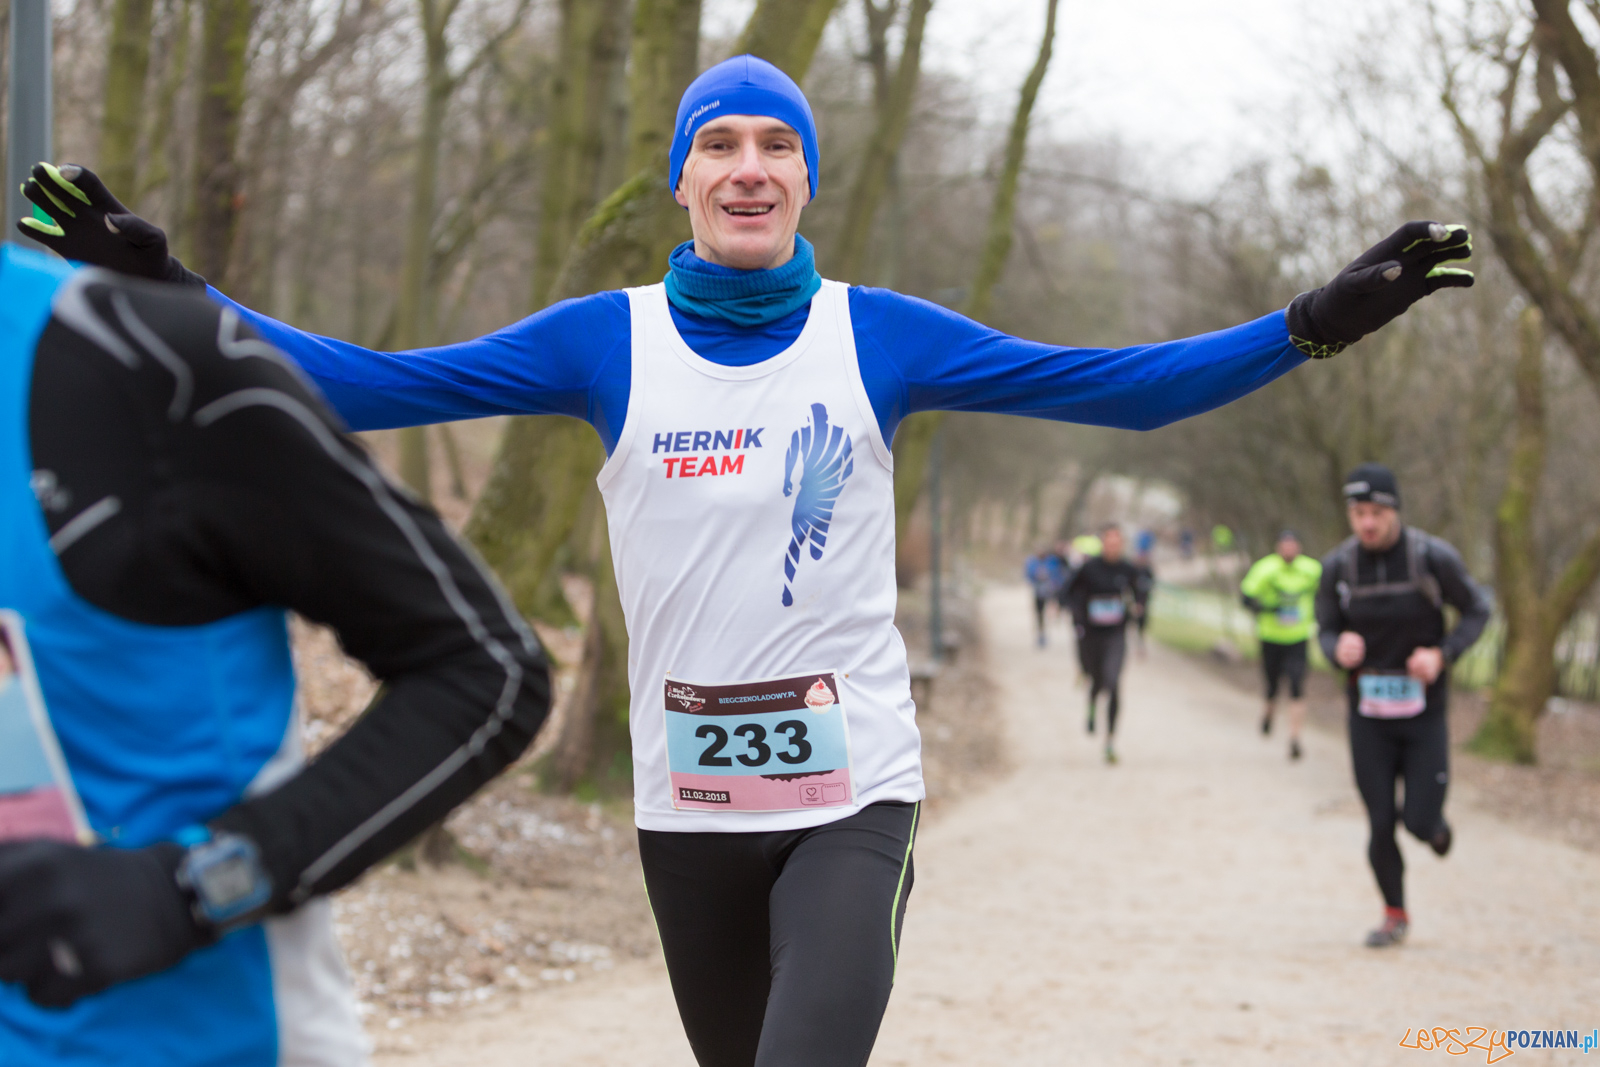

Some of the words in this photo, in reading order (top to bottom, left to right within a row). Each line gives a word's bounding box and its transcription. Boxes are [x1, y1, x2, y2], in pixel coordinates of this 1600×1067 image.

[652, 427, 765, 454] HERNIK
[663, 454, 745, 479] TEAM
[718, 691, 797, 704] BIEGCZEKOLADOWY.PL
[695, 720, 812, 767] 233
[681, 790, 727, 801] 11.02.2018
